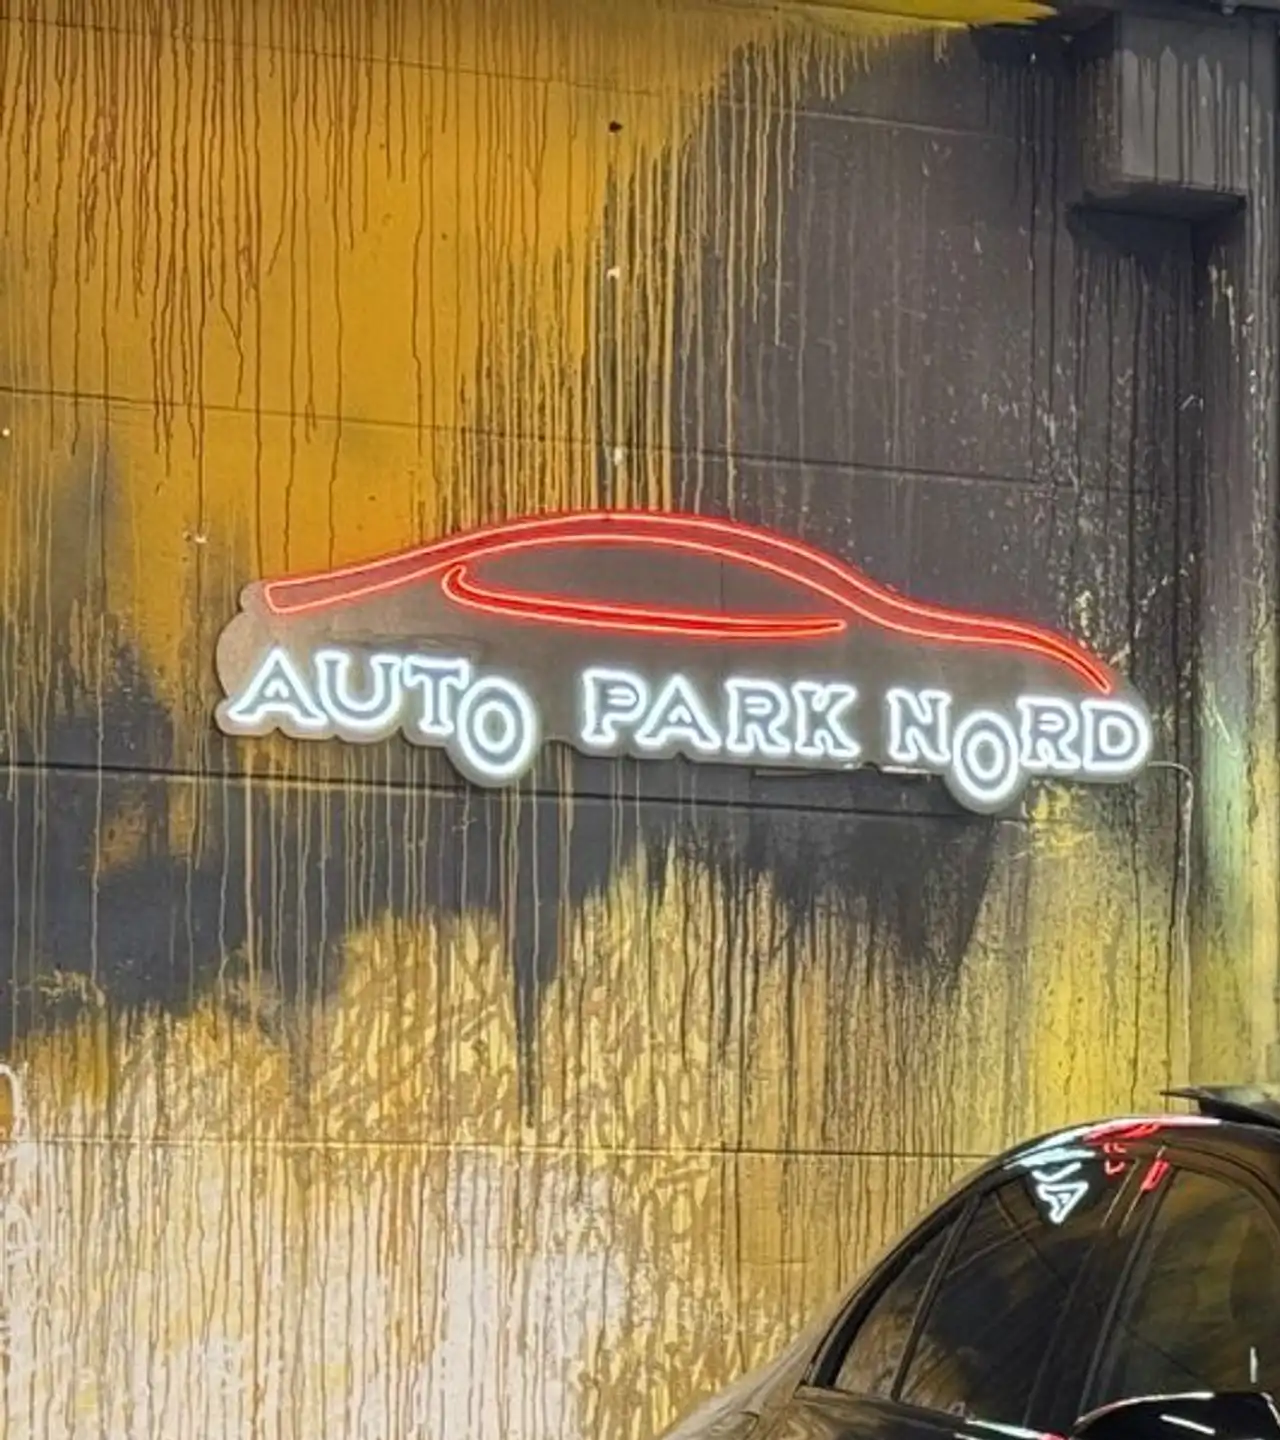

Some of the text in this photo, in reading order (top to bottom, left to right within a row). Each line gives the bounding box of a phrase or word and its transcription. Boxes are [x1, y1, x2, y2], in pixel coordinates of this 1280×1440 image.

[230, 646, 1150, 802] AUTO PARK NORD
